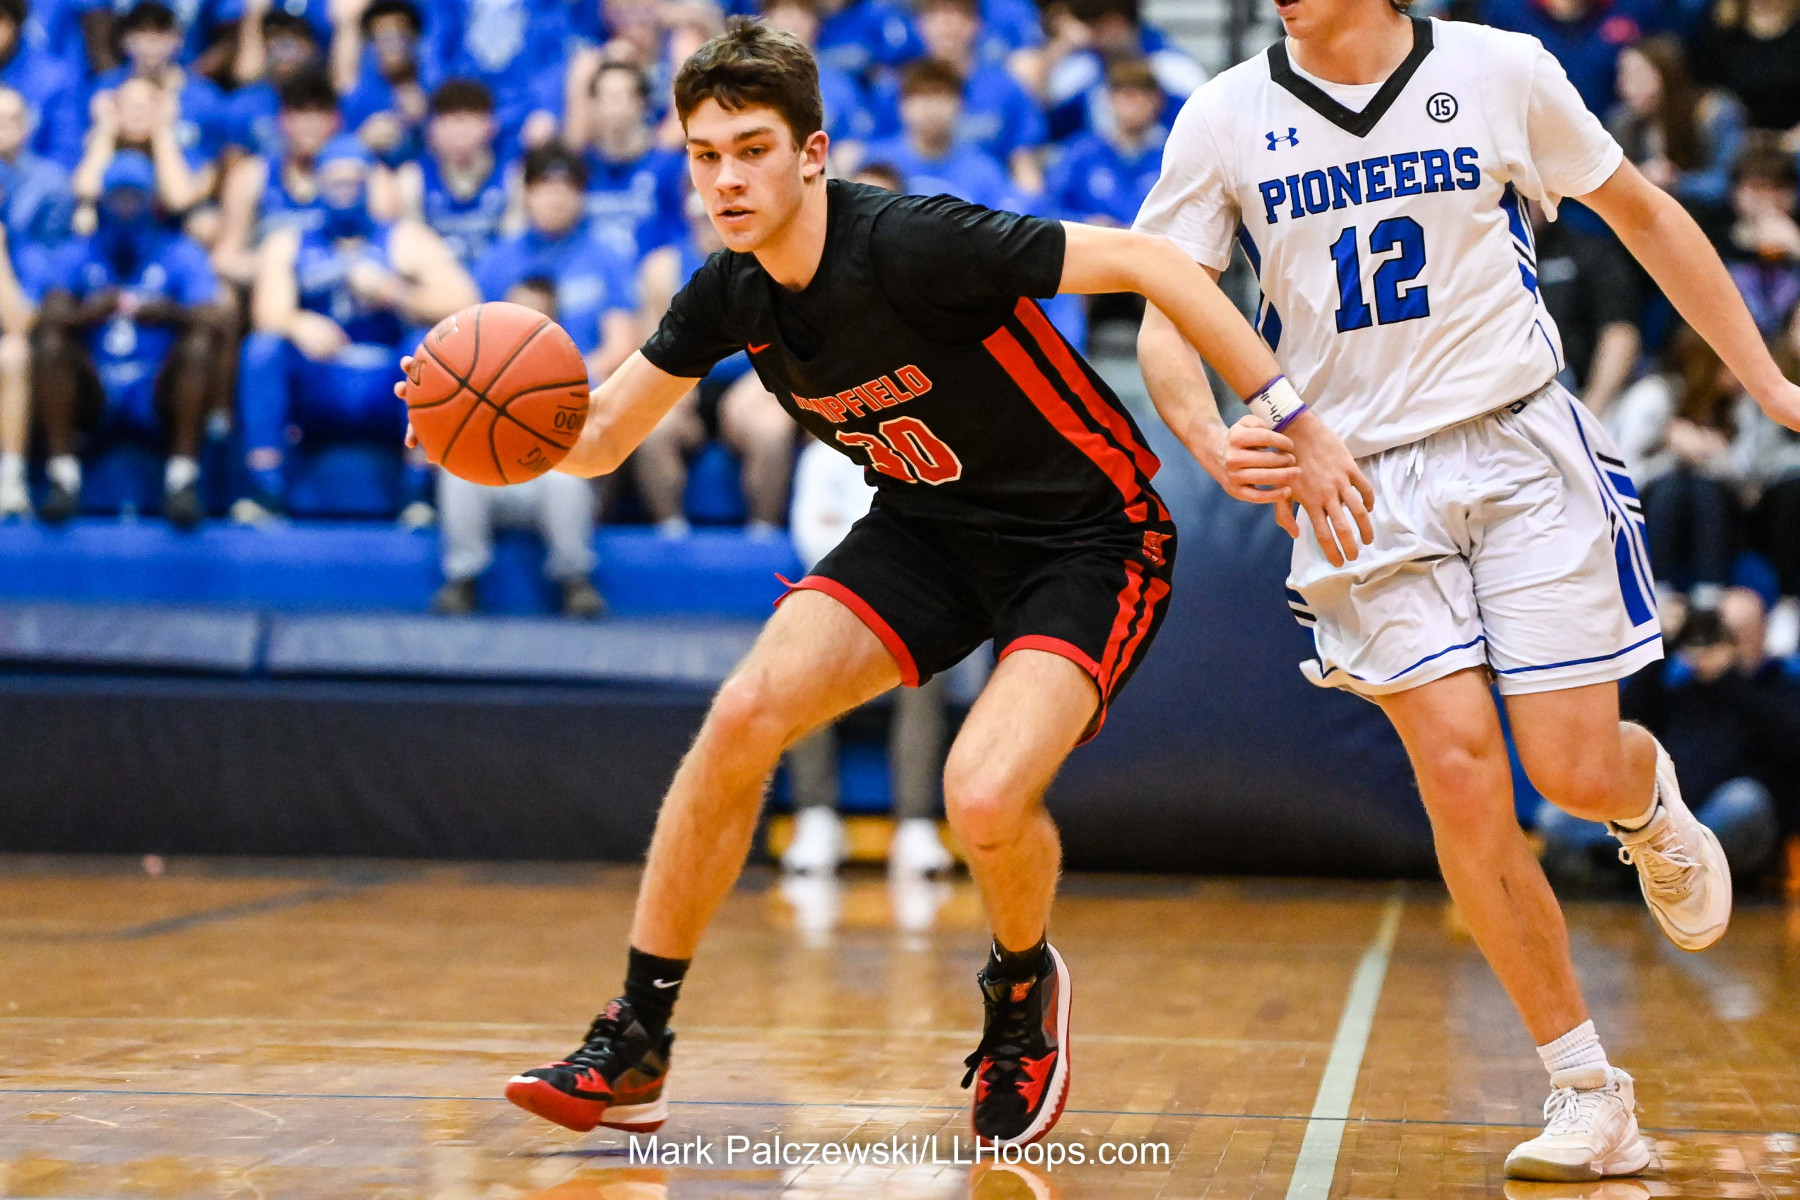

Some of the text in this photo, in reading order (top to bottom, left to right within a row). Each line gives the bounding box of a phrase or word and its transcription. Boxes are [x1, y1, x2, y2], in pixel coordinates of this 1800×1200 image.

[1433, 98, 1451, 116] 15
[1258, 147, 1481, 225] PIONEERS
[1329, 215, 1431, 334] 12
[835, 415, 963, 486] 30
